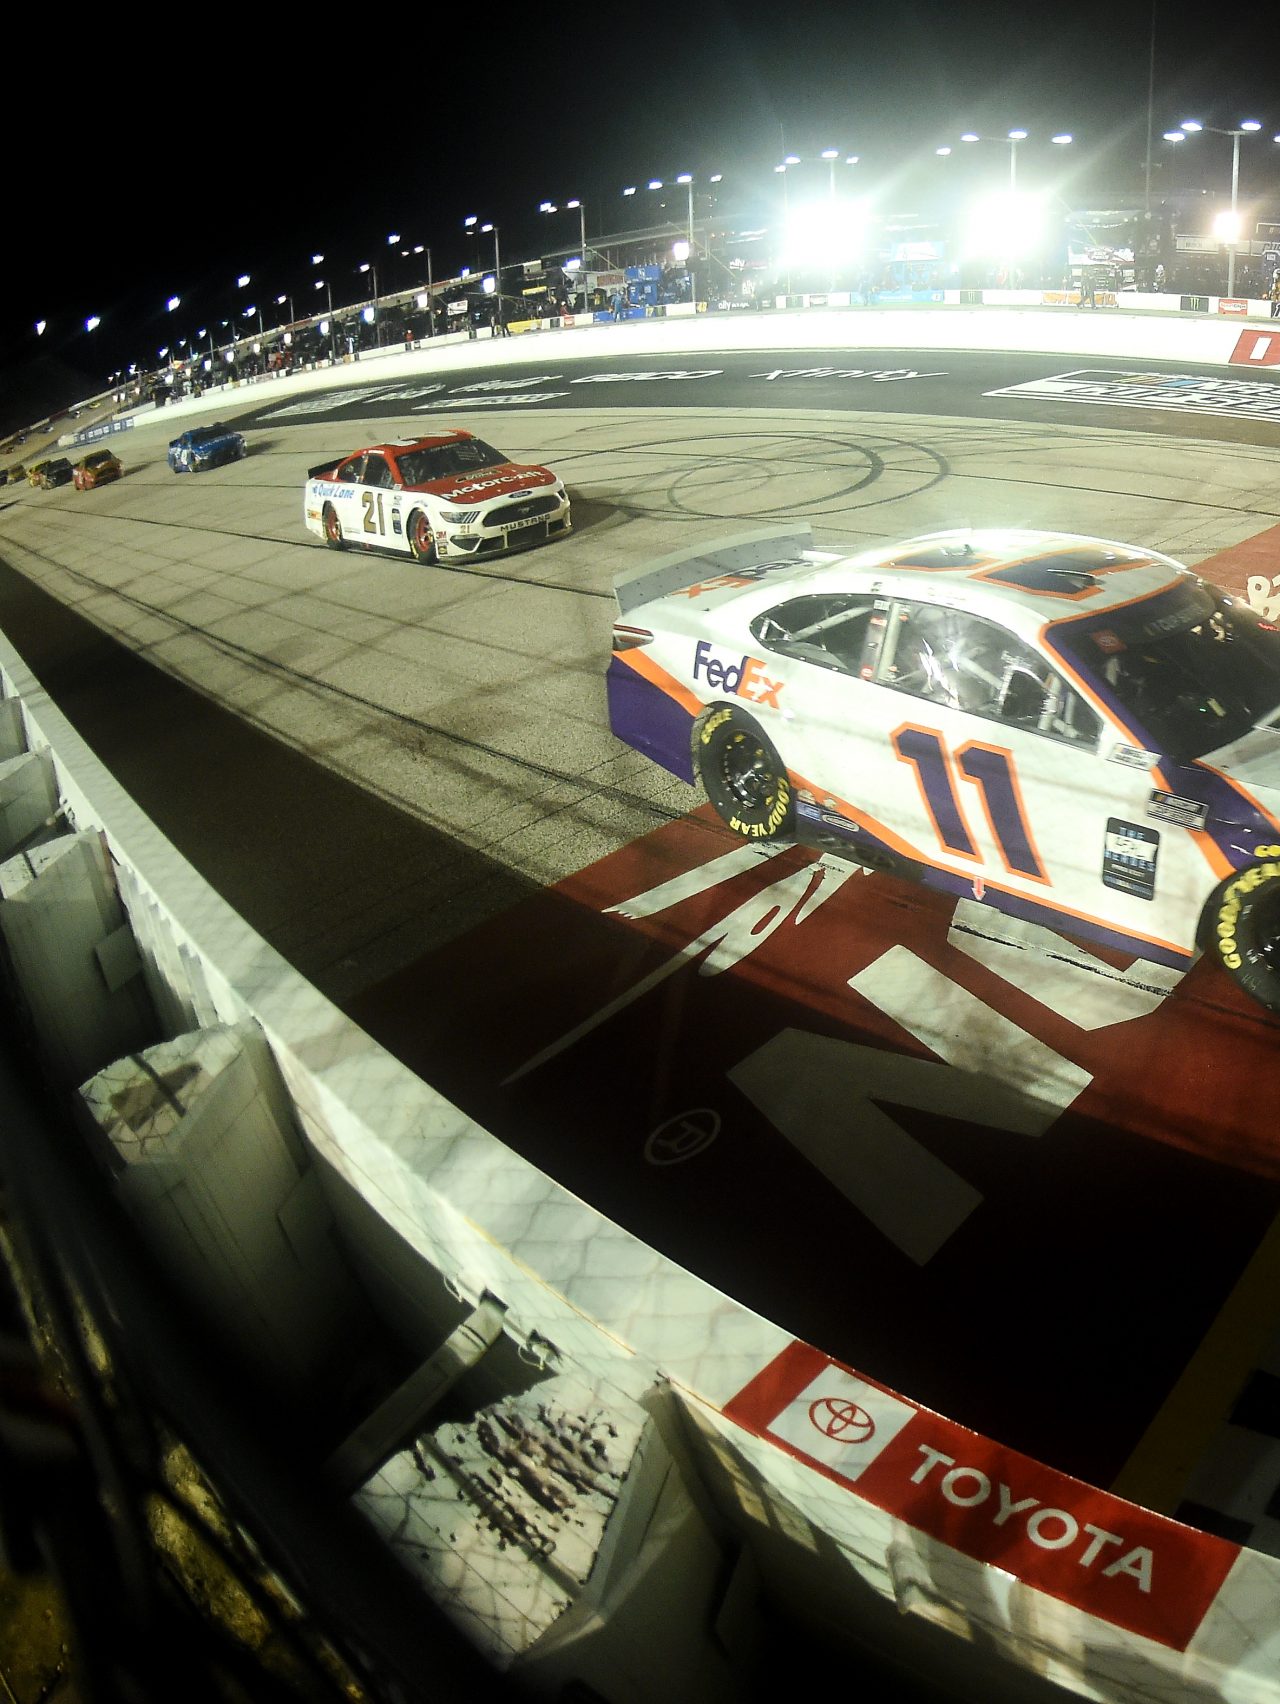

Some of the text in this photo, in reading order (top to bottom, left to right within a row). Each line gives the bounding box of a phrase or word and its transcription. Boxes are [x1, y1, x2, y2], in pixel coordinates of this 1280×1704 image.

[1065, 385, 1176, 403] CUP
[334, 486, 355, 499] Lane
[362, 491, 386, 536] 21
[500, 513, 551, 531] MUSTANG
[694, 641, 785, 709] FedEx
[730, 777, 790, 837] GOODYEAR
[889, 722, 1052, 887] 11
[910, 1444, 1155, 1593] TOYOTA
